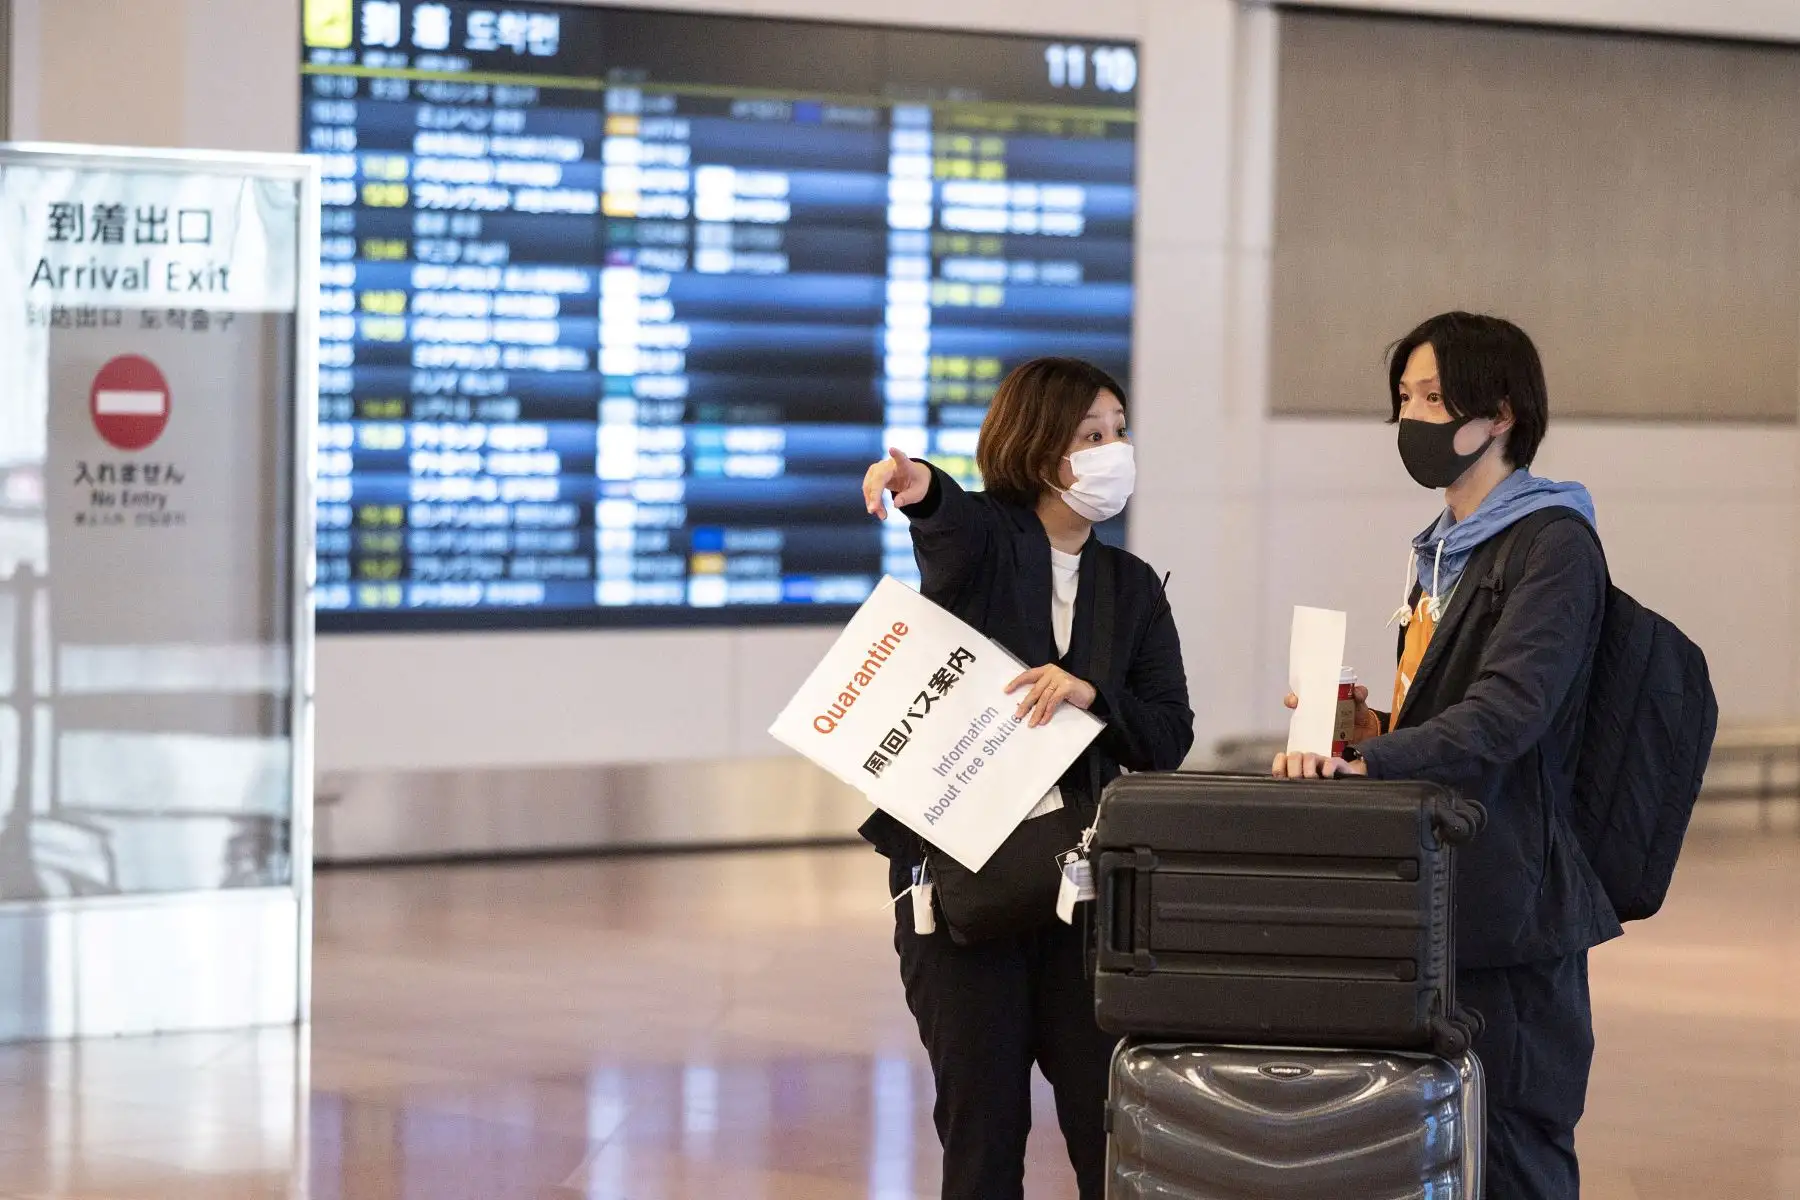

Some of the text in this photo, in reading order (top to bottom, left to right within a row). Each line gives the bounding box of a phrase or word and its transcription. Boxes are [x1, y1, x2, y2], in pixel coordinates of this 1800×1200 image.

[47, 201, 212, 245] 到着出口
[30, 256, 230, 292] Arrival Exit
[74, 460, 186, 487] 入れません
[91, 489, 168, 511] No Entry
[813, 621, 909, 734] Quarantine
[862, 646, 977, 777] 周回バス案内
[932, 706, 999, 777] Information
[923, 783, 961, 826] About
[955, 756, 984, 785] free
